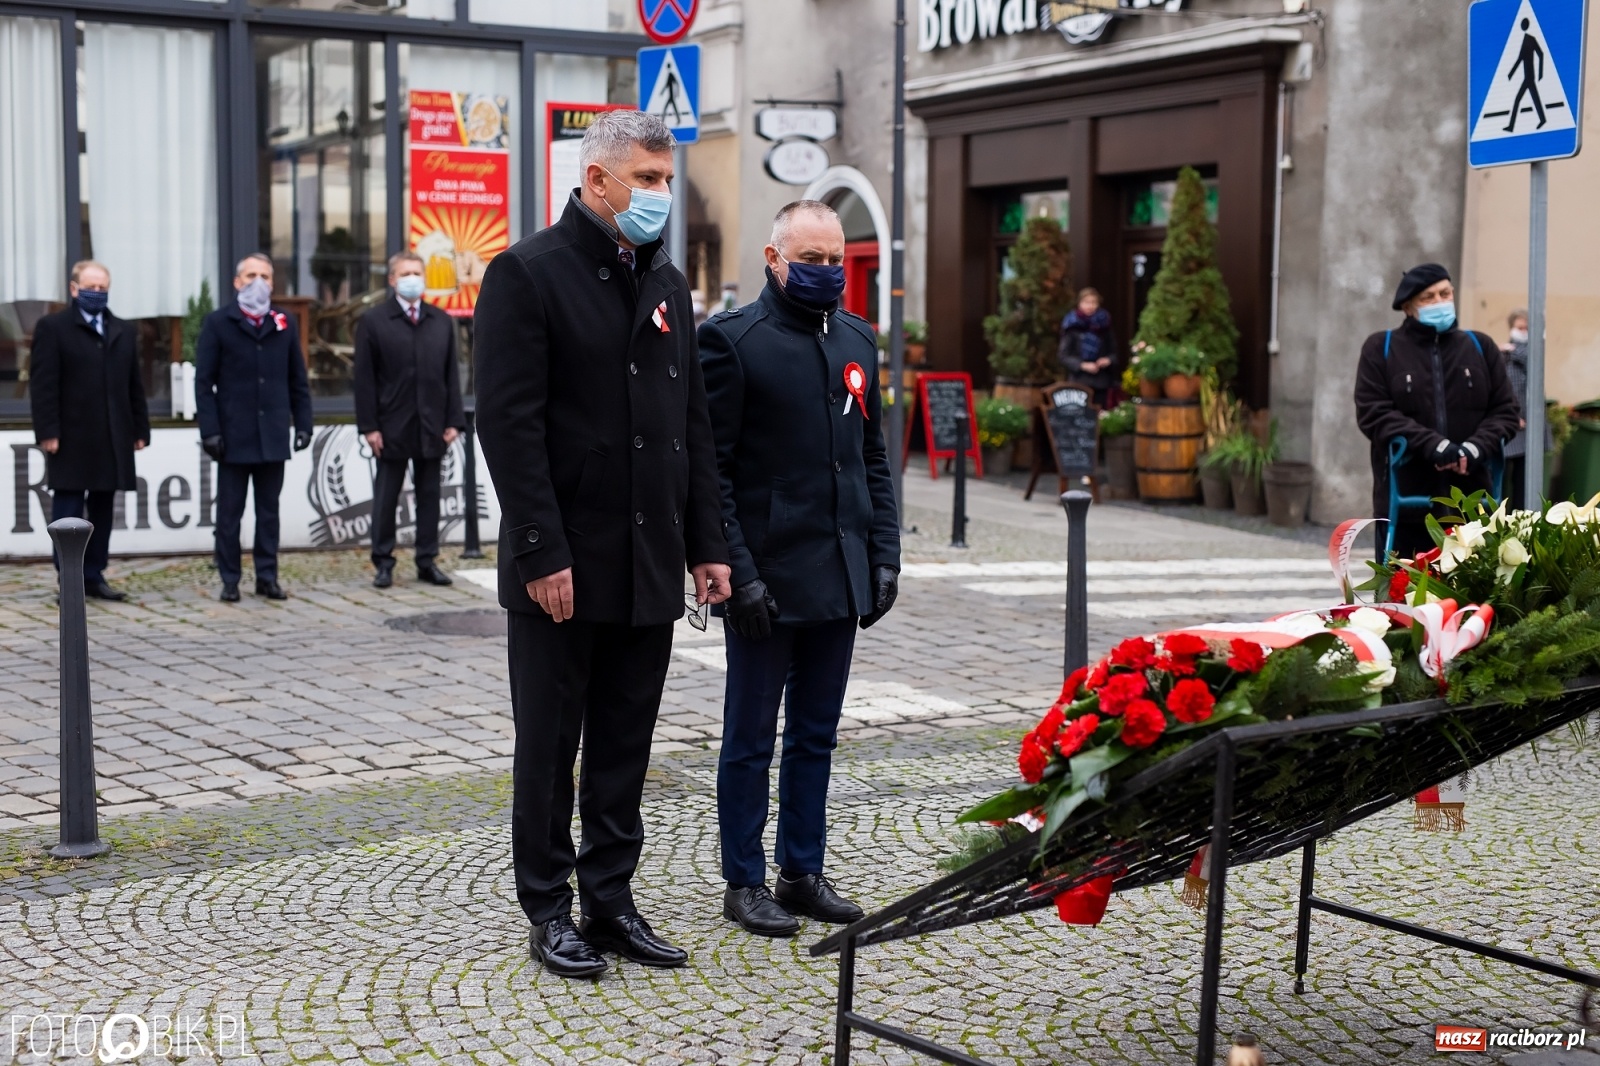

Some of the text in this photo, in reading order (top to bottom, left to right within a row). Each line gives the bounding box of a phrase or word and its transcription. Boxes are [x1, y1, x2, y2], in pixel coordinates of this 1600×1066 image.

[434, 179, 486, 192] DWA PIWA
[416, 190, 503, 205] W CENIE JEDNEGO
[1053, 388, 1088, 407] HEINZ
